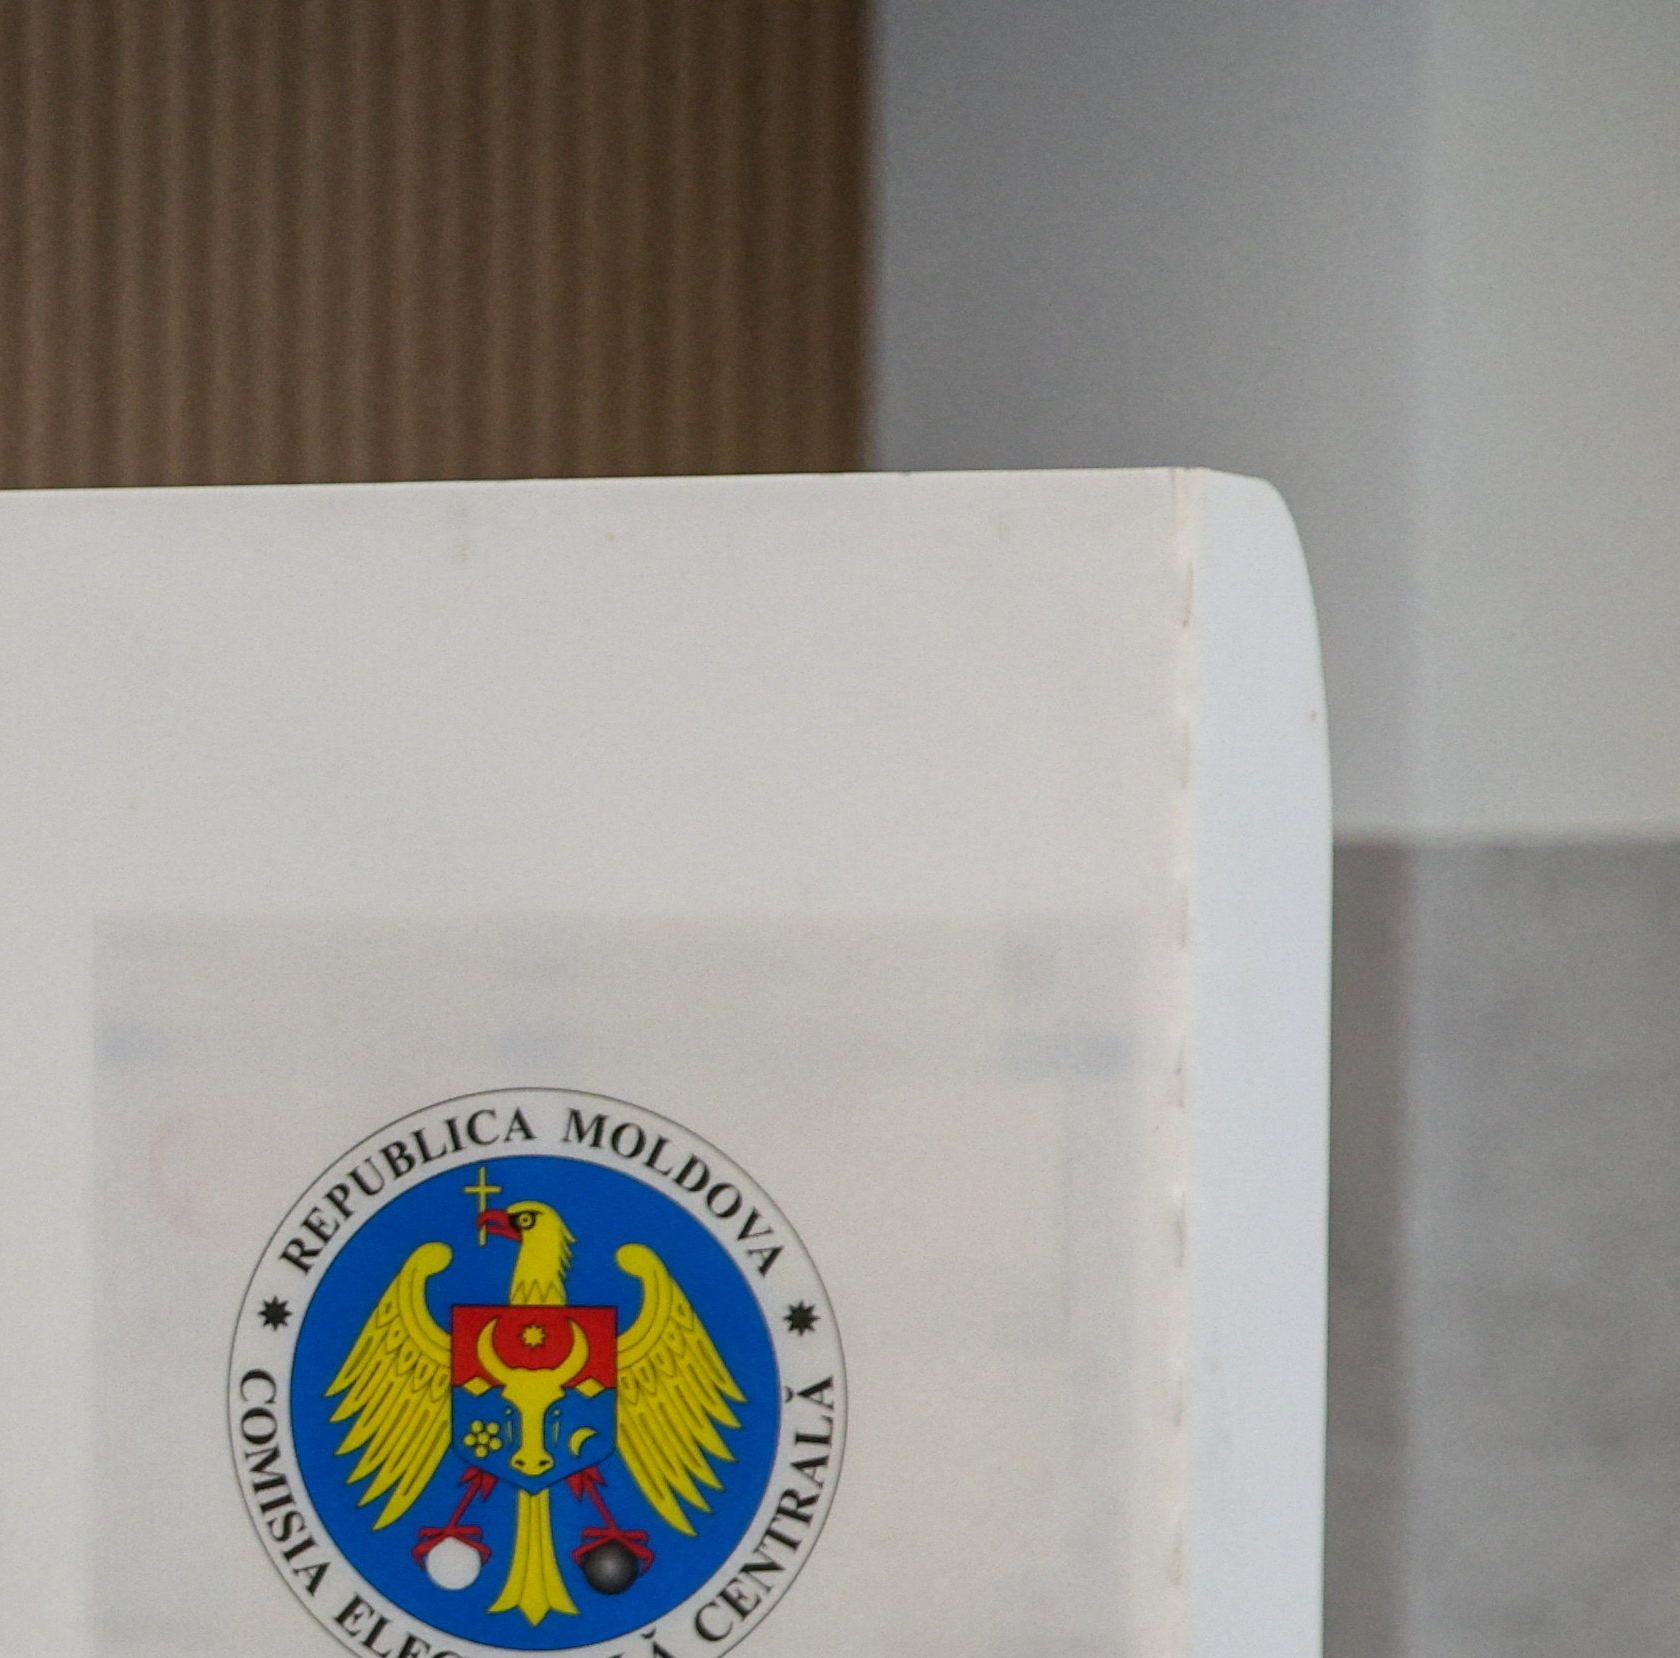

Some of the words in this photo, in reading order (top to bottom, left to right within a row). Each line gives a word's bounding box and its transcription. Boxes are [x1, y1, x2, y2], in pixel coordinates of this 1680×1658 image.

[279, 1107, 538, 1276] REPUBLICA
[562, 1107, 786, 1278] MOLDOVA
[239, 1369, 332, 1597] COMISIA
[693, 1375, 835, 1643] CENTRALĂ
